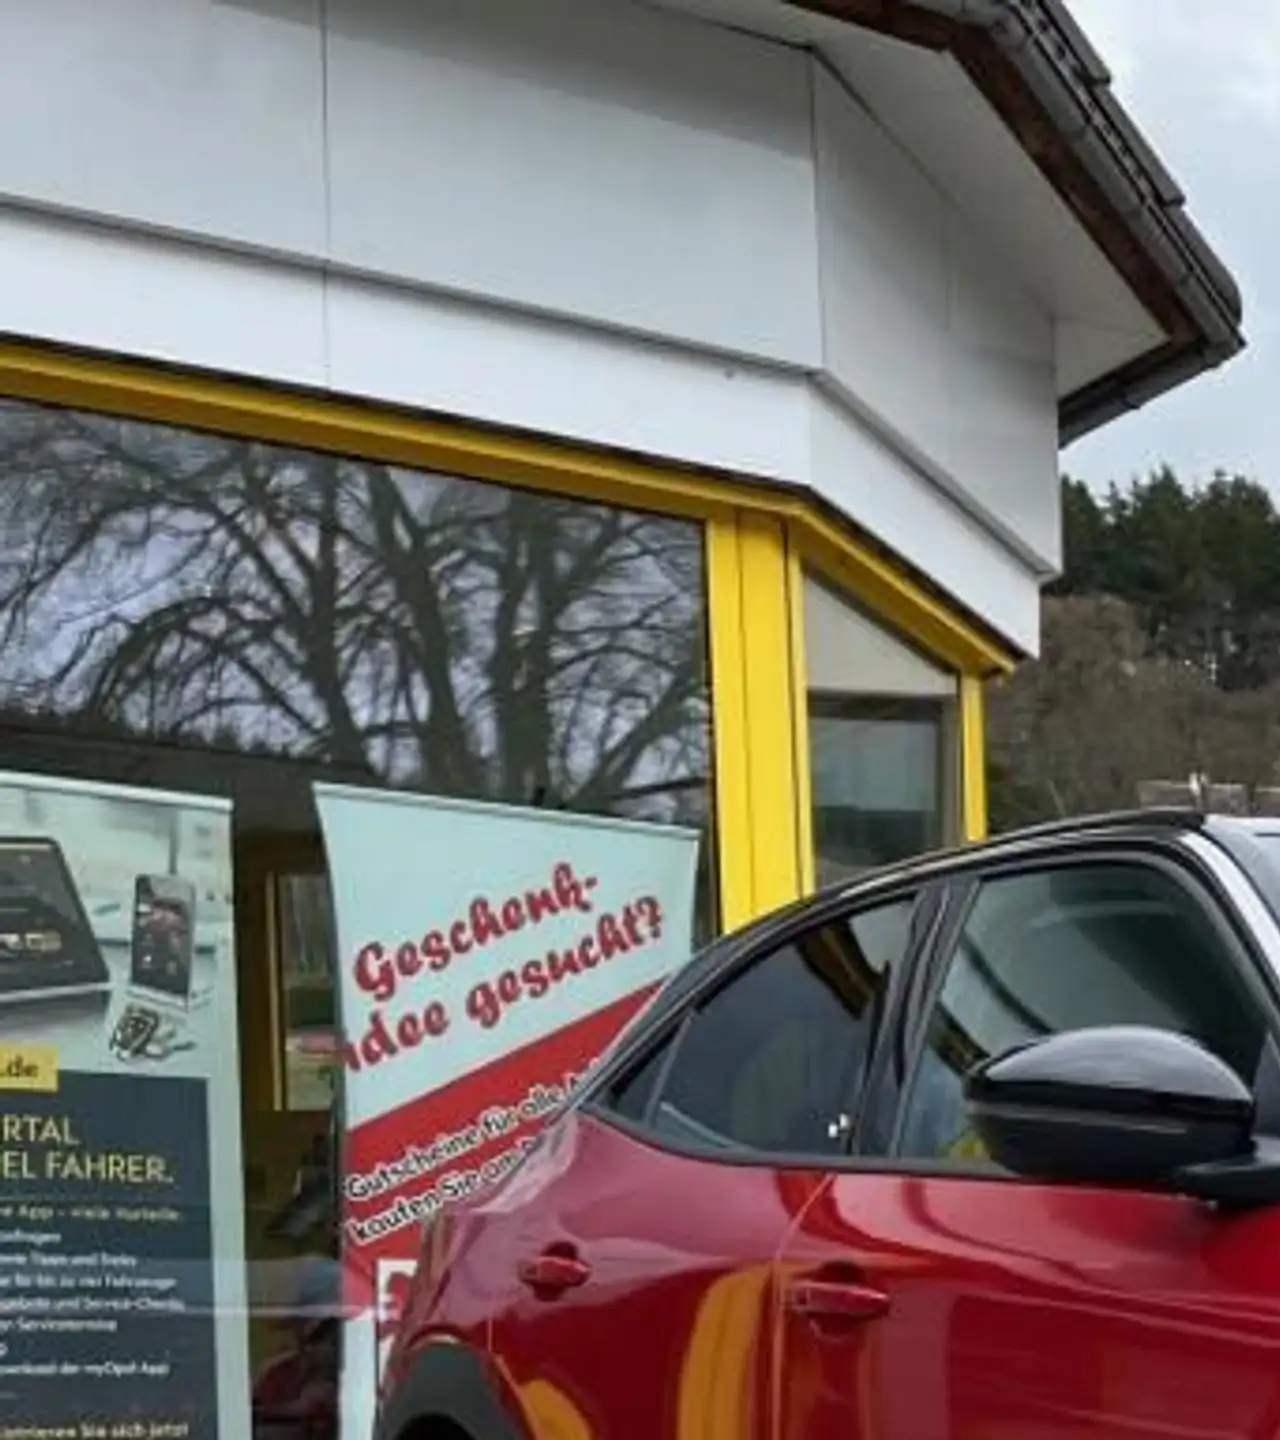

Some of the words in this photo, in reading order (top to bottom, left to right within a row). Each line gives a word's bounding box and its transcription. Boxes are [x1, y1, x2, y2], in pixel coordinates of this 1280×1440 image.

[354, 863, 598, 1001] Geschenk-
[465, 895, 662, 1029] gesucht?
[2, 1113, 80, 1145] RTAL
[3, 1151, 37, 1180] EL
[45, 1152, 175, 1184] FAHRER.
[346, 1132, 480, 1201] Gutscheine
[348, 1189, 443, 1246] kaufen
